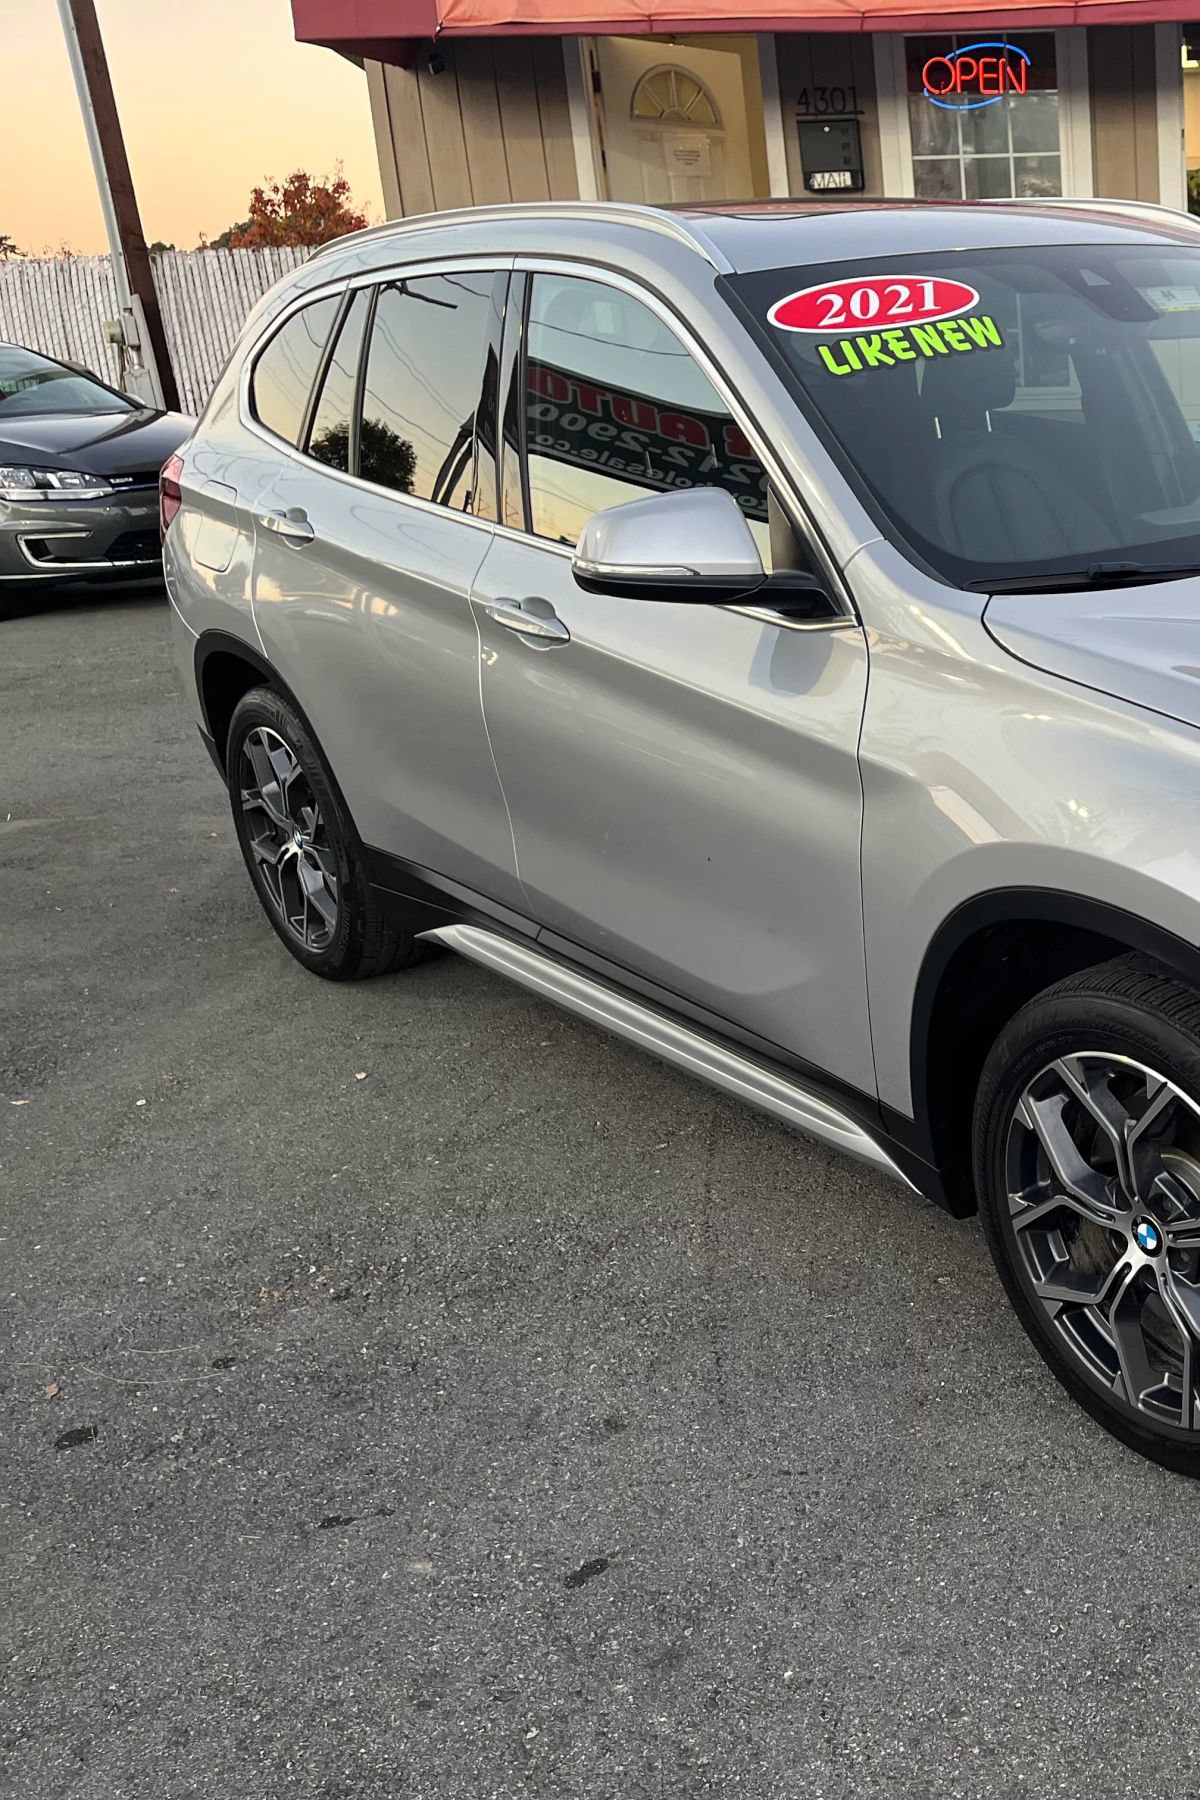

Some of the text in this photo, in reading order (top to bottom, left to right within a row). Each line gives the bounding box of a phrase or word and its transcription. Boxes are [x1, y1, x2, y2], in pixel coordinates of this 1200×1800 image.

[922, 56, 1026, 95] OPEN
[797, 86, 858, 113] 4301
[810, 172, 853, 189] MAIL
[816, 281, 942, 326] 2021
